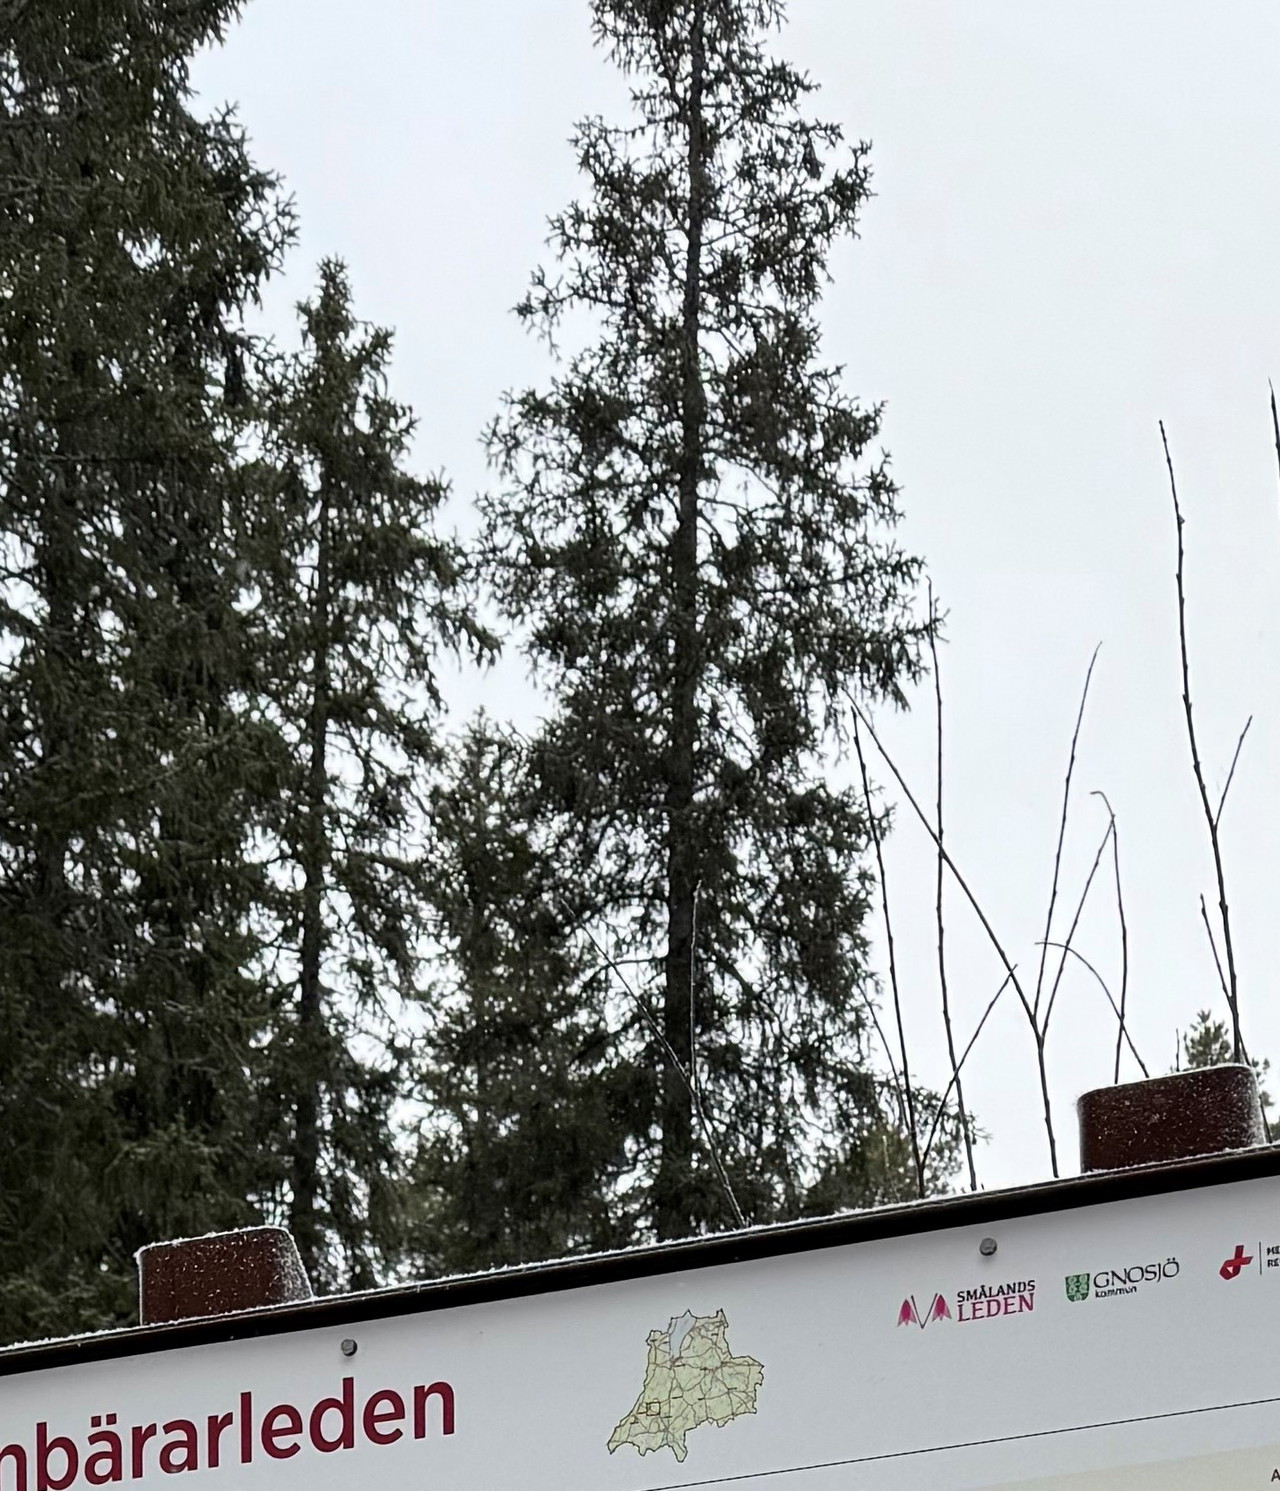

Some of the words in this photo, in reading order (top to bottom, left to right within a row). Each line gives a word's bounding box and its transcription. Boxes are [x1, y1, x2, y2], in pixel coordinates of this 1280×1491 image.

[1093, 1257, 1179, 1288] GNOSJÖ
[957, 1280, 1035, 1307] SMÅLANDS
[1095, 1286, 1137, 1297] kommun
[957, 1292, 1034, 1322] LEDEN
